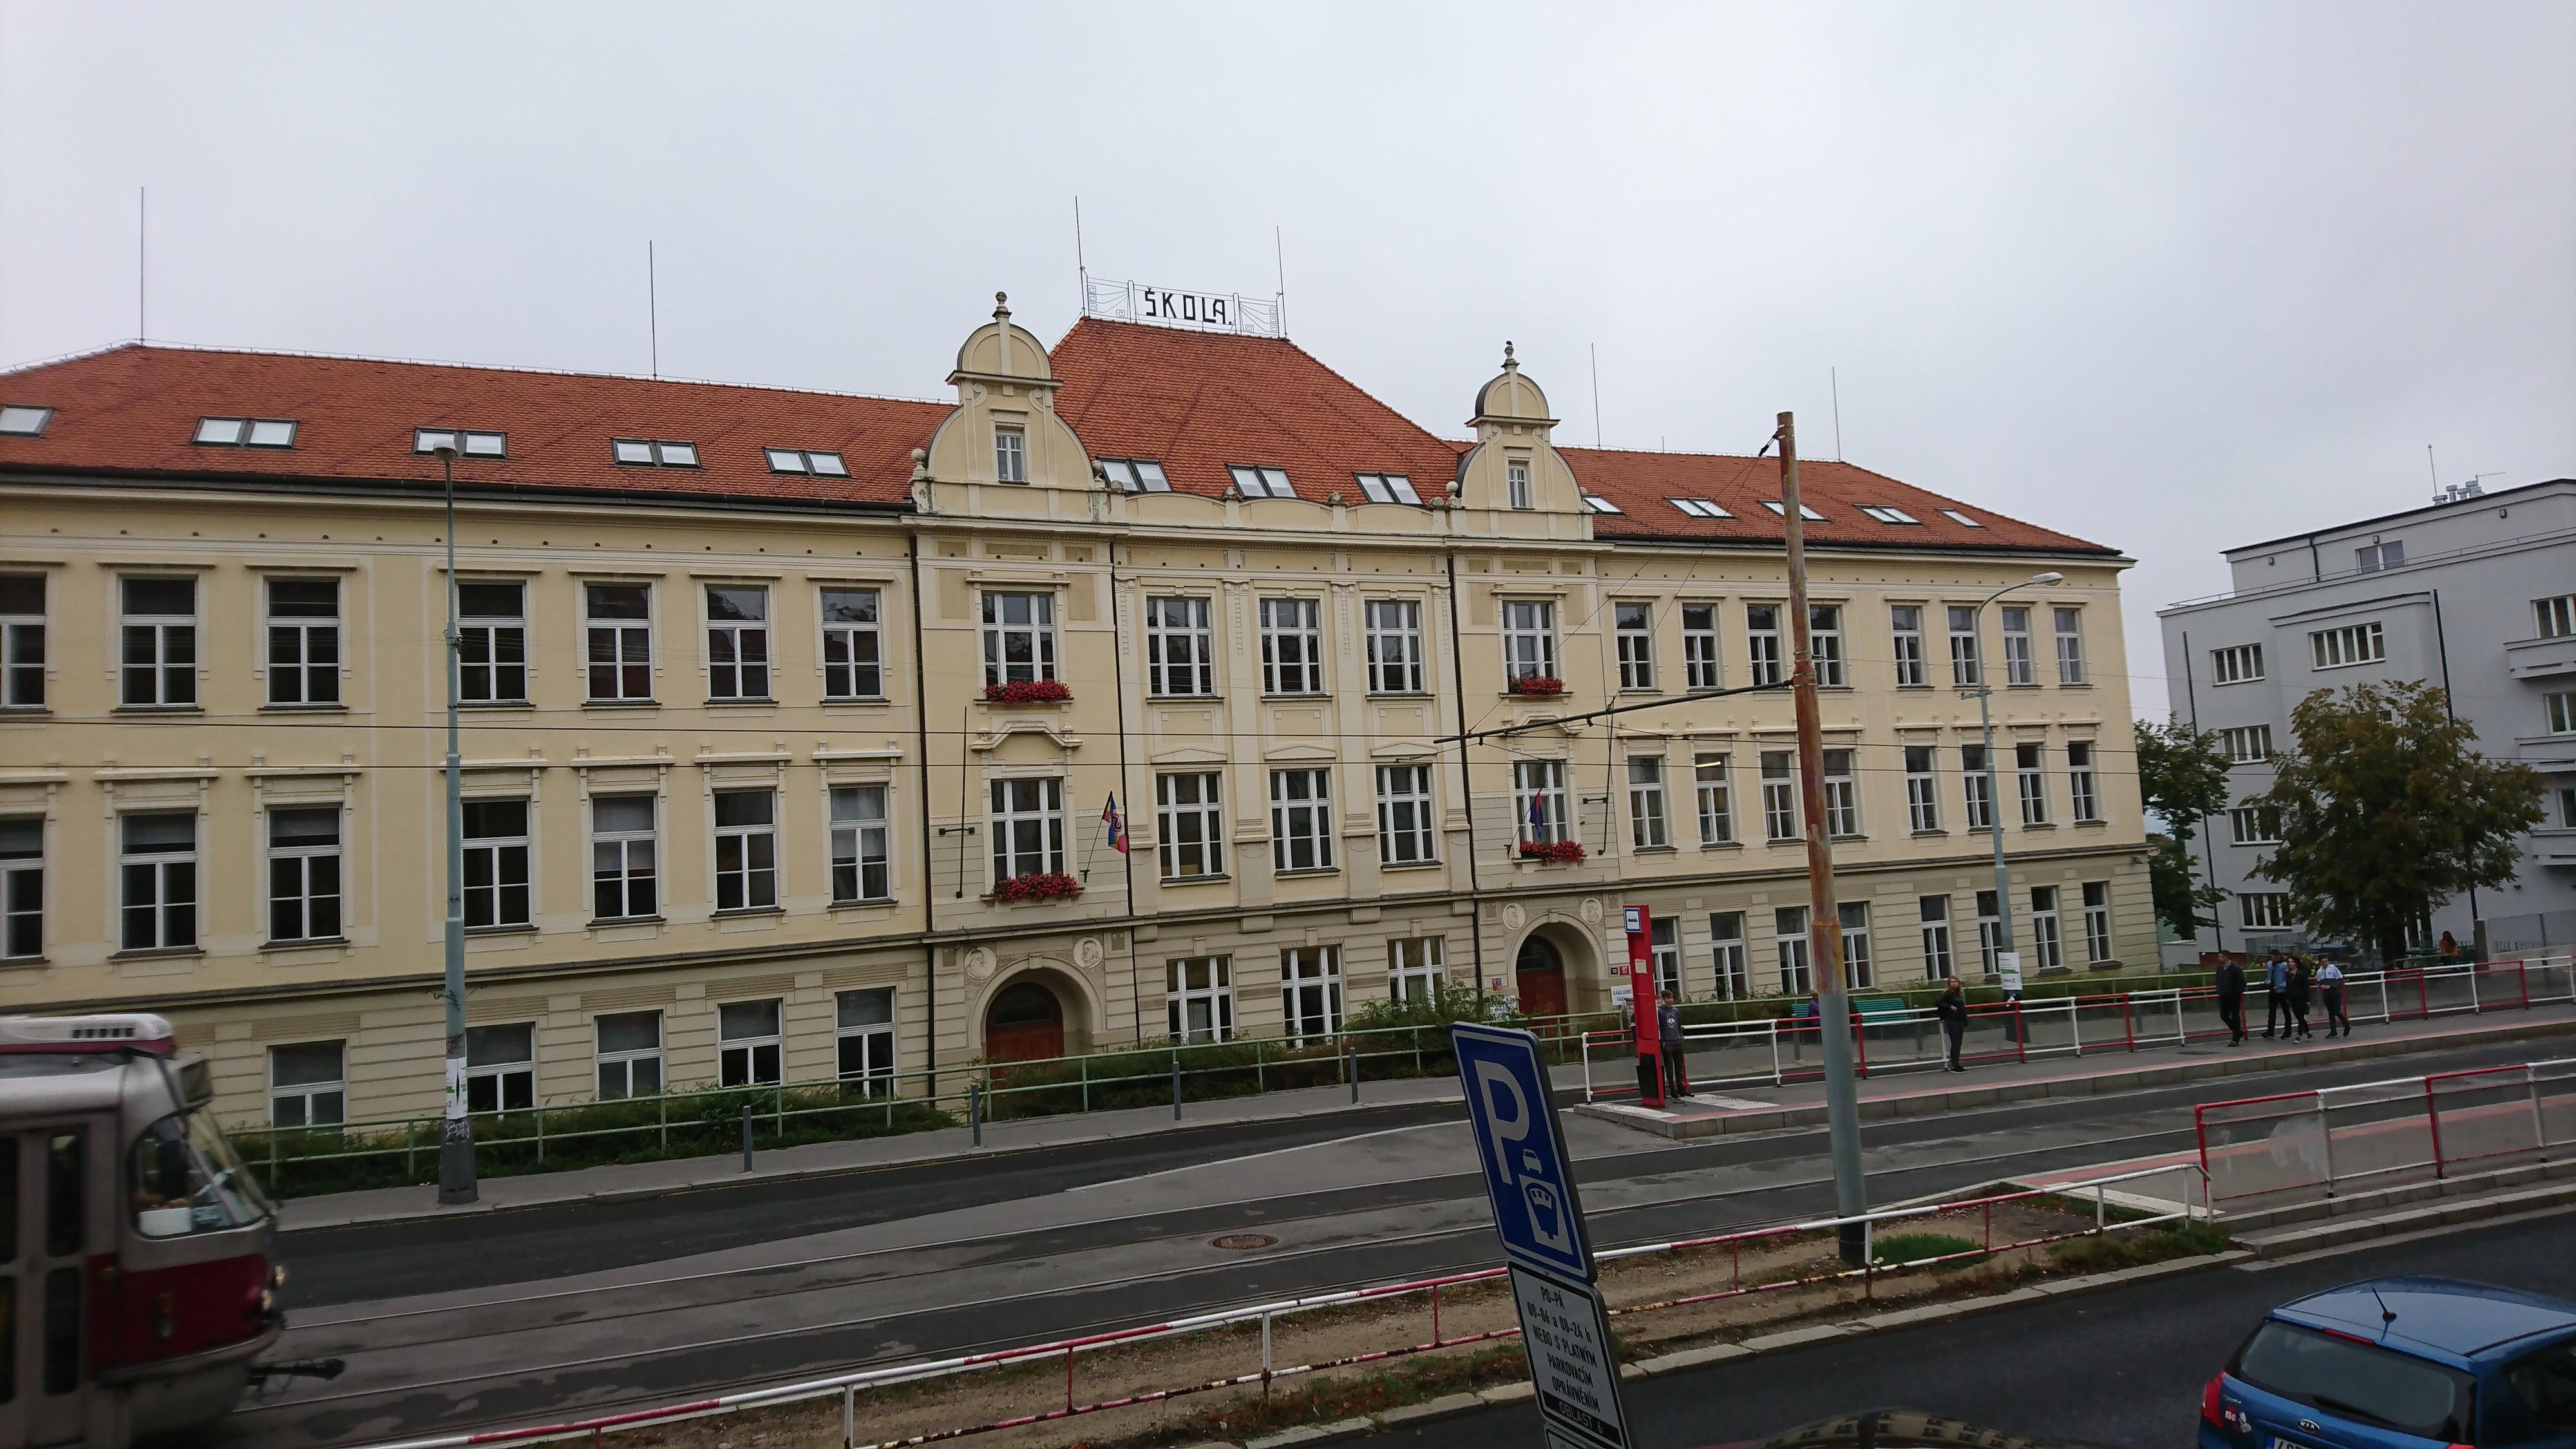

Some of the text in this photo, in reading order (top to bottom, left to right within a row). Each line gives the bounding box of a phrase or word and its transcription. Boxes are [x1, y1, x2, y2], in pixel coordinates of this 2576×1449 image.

[1144, 287, 1232, 325] ŠKOLA.
[1473, 1058, 1530, 1186] P
[1540, 1285, 1566, 1310] PO-PÁ
[1527, 1302, 1592, 1344] 00-06 a 08-24 h
[1533, 1325, 1597, 1368] NEBO S PLATNÝM
[1547, 1352, 1594, 1388] PARKOVACÍM
[1551, 1376, 1601, 1414] OPRÁVNĚNÍM
[1559, 1401, 1604, 1434] OBLAST 6
[2299, 1420, 2315, 1430] KIA
